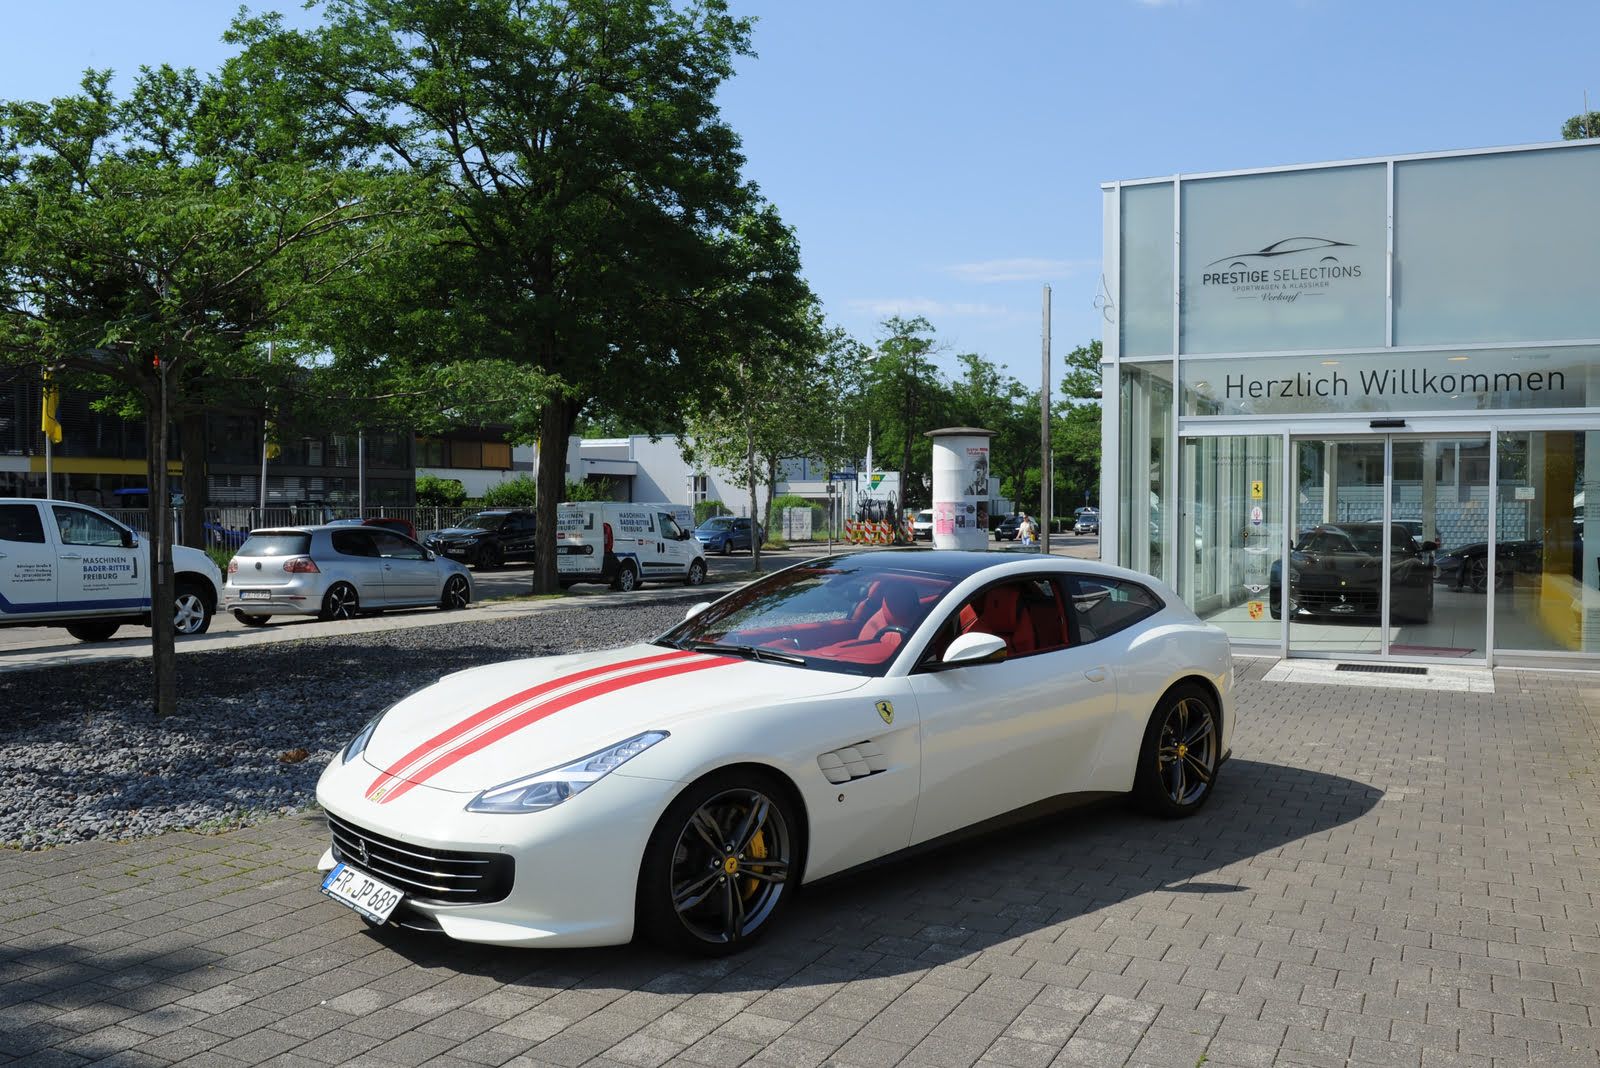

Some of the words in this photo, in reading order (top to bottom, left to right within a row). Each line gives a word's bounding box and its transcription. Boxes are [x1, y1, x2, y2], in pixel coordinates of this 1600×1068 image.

[1203, 270, 1269, 286] PRESTIGE
[1273, 265, 1362, 282] SELECTIONS
[1232, 284, 1280, 292] SPORTWAGEN
[1289, 281, 1330, 289] KLASSIKER
[1261, 291, 1302, 303] Verkauf
[1226, 371, 1348, 399] Herzlich
[1360, 368, 1565, 395] Willkommen
[83, 564, 130, 572] BADER-RITTER
[331, 868, 355, 892] FR
